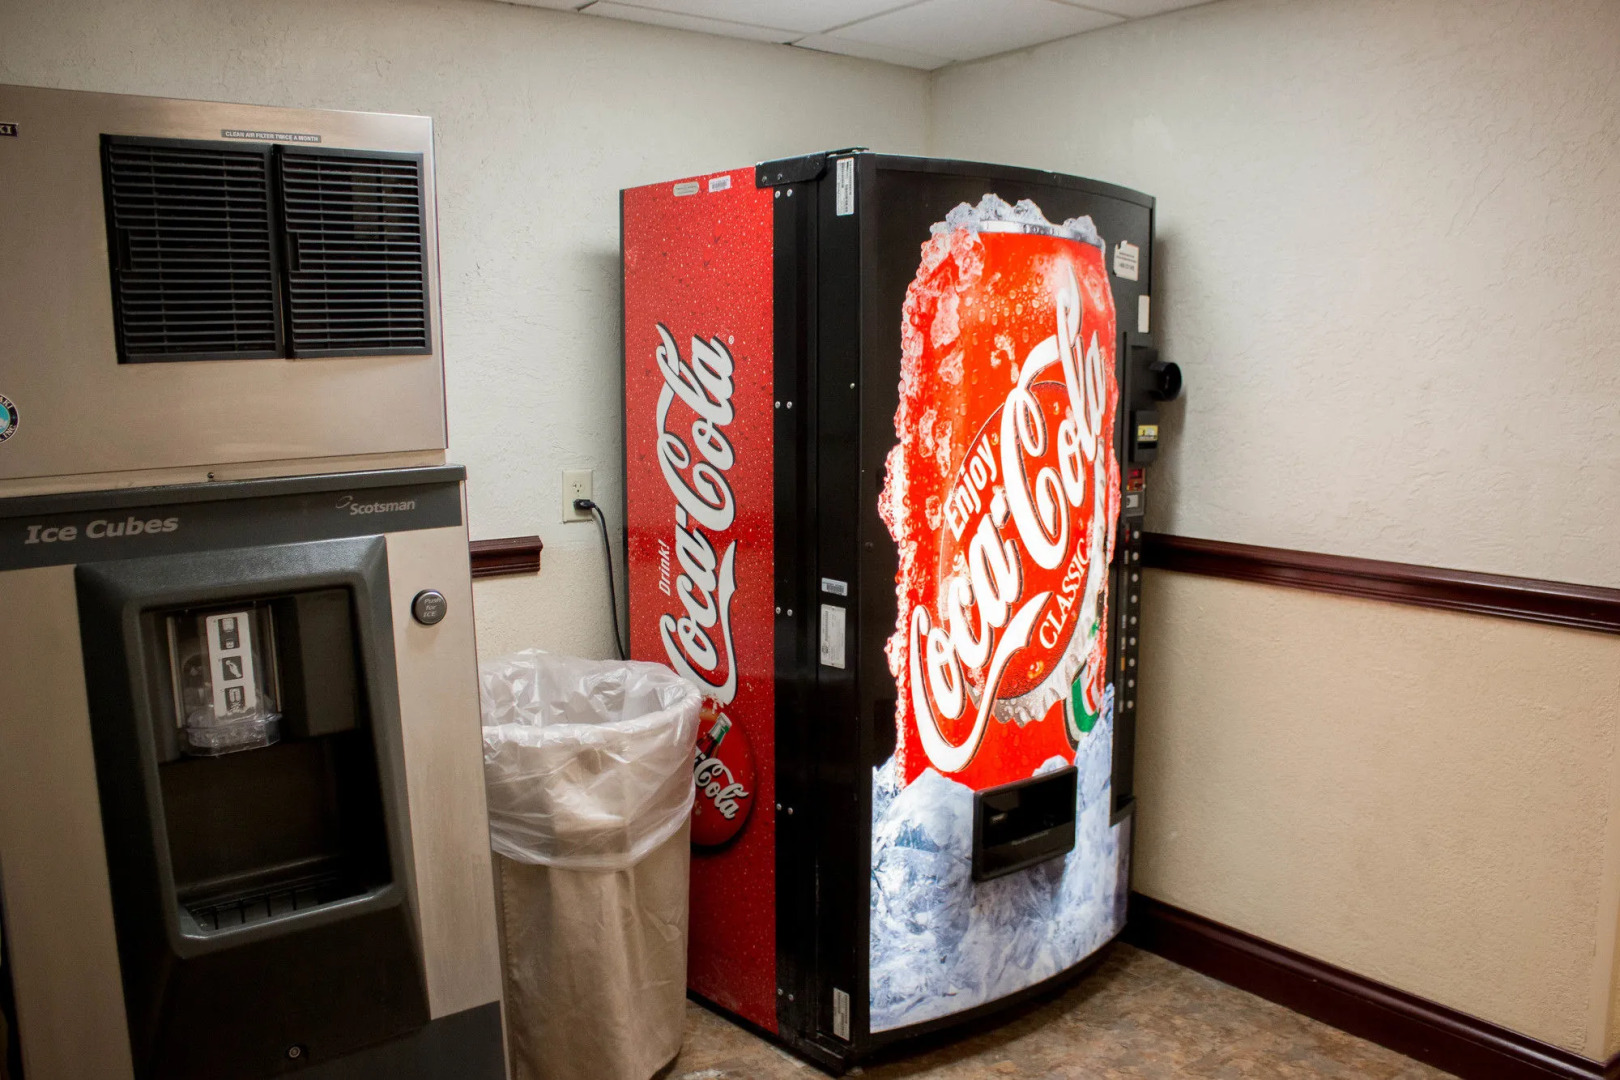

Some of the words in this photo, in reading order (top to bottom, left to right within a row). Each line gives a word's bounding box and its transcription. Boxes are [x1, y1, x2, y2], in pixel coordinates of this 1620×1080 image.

[350, 500, 416, 516] Scotsman
[912, 264, 1106, 772] Coca-Cola
[943, 434, 997, 542] Enjoy
[24, 525, 78, 545] Ice
[85, 516, 179, 539] Cubes
[658, 539, 670, 597] Drink!
[1039, 538, 1091, 649] CLASSIC
